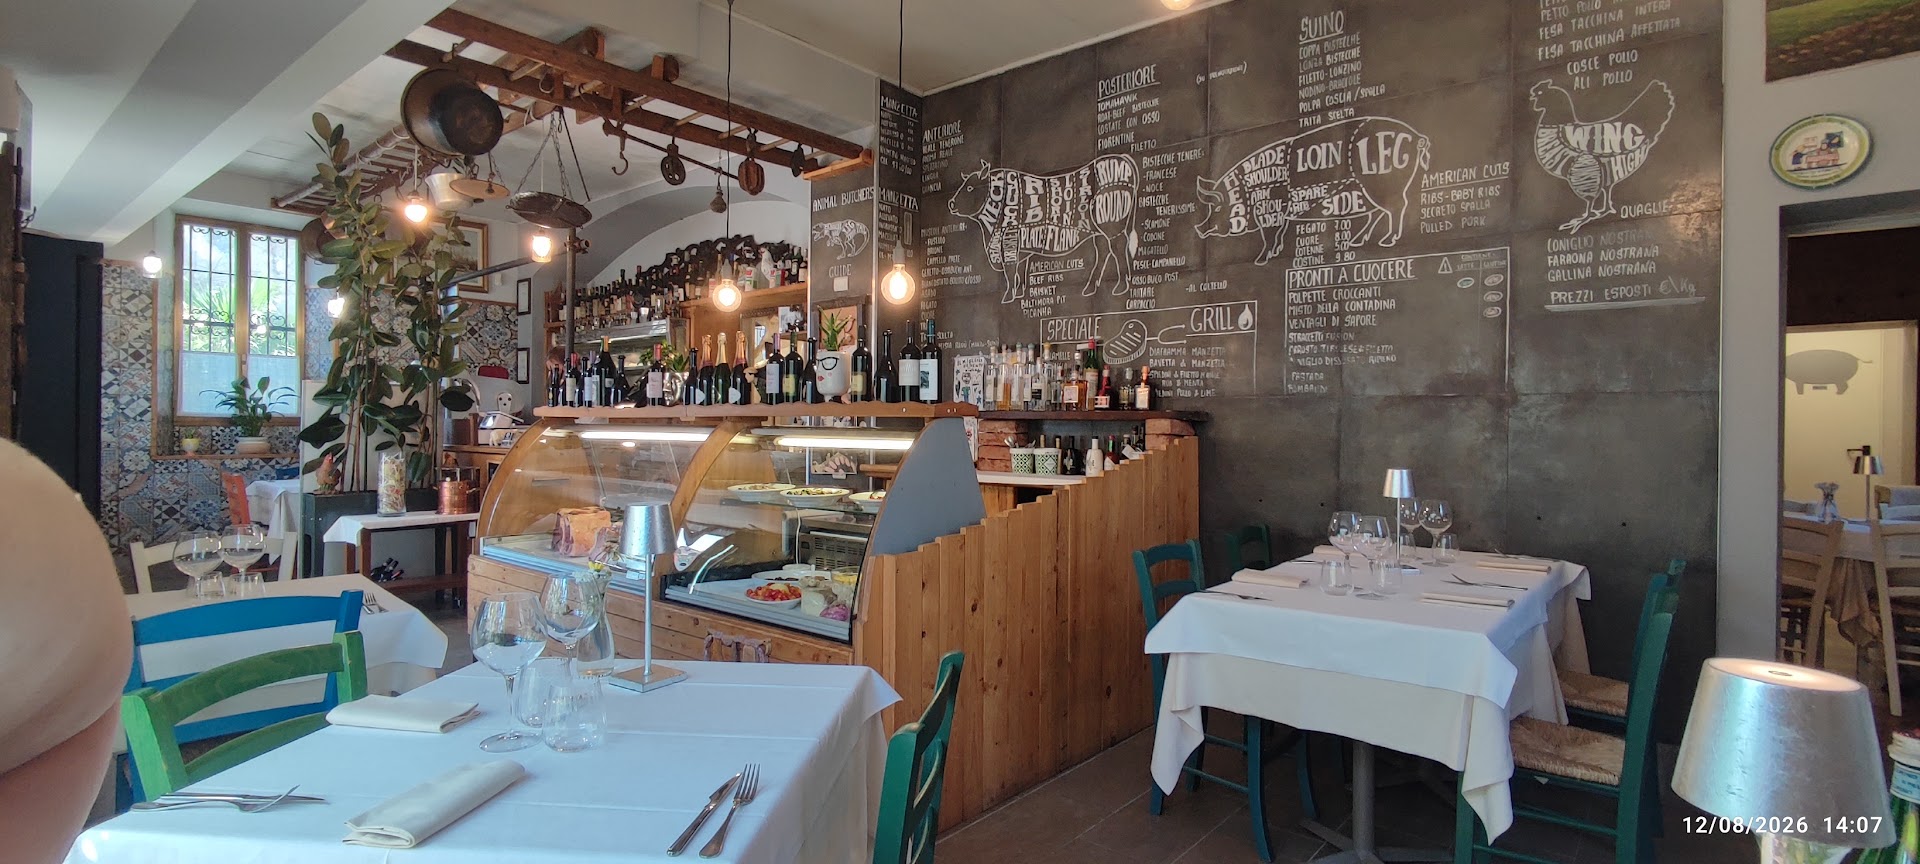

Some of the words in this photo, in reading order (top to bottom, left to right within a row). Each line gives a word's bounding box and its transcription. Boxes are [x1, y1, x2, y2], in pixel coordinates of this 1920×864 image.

[1540, 5, 1569, 22] PETTO
[1299, 10, 1344, 41] SUINO
[1540, 23, 1563, 40] FESA
[1571, 9, 1624, 31] TACCHINA
[1299, 44, 1320, 60] COPPA
[1324, 32, 1360, 53] BISTECCHE
[1538, 44, 1563, 61] FESA
[1570, 28, 1624, 53] TACCHINA
[1631, 17, 1681, 38] AFFETTATA
[1326, 46, 1361, 66] BISTECCHE
[1567, 56, 1600, 75] COSCE
[1609, 50, 1638, 66] POLLO
[1098, 63, 1157, 97] POSTERIORE
[1574, 76, 1590, 91] ALI
[1603, 70, 1633, 86] POLLO
[881, 95, 918, 118] MANZETTA
[1098, 93, 1138, 112] TOMAHAWK
[1299, 98, 1321, 113] POLPA
[1097, 122, 1122, 135] COSTATE
[1142, 110, 1161, 125] OSSO
[1298, 115, 1321, 128] TRITA
[1328, 108, 1355, 121] SCELTA
[922, 120, 962, 143] ANTERIORE
[1098, 132, 1135, 150] FIORENTINE
[1565, 121, 1646, 154] WING
[1130, 139, 1157, 153] FILETTO
[1356, 131, 1413, 175] LEG
[1142, 154, 1175, 169] BISTECCHE
[1242, 145, 1286, 175] BLADE
[1296, 141, 1343, 173] LOIN
[1600, 138, 1651, 187] THIGH
[1096, 158, 1132, 187] RUMP
[1243, 166, 1288, 187] SHOULDER
[1421, 167, 1478, 189] AMERICAN
[1483, 161, 1510, 178] CUTS
[812, 195, 838, 213] ANIMAL
[841, 186, 875, 206] BUTCHERS
[879, 186, 919, 210] MANZETTA
[1023, 176, 1045, 224] RIB
[1063, 175, 1073, 226] LOIN
[1223, 170, 1247, 234] HEAD
[1251, 188, 1271, 203] ARM
[1291, 186, 1329, 202] SPARE
[1478, 185, 1501, 198] RIBS
[978, 171, 1004, 234] NECK
[1095, 190, 1132, 225] ROUND
[1321, 191, 1367, 216] SIDE
[1420, 204, 1456, 219] SECRETO
[1460, 199, 1491, 213] SPALLA
[1620, 201, 1669, 219] QUAGLIE
[1259, 213, 1285, 228] LDER
[1296, 222, 1327, 235] FEGATO
[1420, 220, 1453, 234] PULLED
[1461, 216, 1487, 229] PORK
[1020, 227, 1044, 249] PLATE
[1045, 225, 1080, 252] FLANK
[1295, 235, 1320, 248] CUORE
[1547, 234, 1594, 253] CONIGLIO
[1295, 244, 1324, 257] COTENNE
[1547, 251, 1593, 268] FARAONA
[1600, 245, 1659, 262] NOSTRANA
[828, 264, 852, 279] GUIDE
[1029, 260, 1064, 273] AMERICAN
[1066, 259, 1084, 269] CUTS
[1292, 255, 1326, 269] COSTINE
[1547, 266, 1592, 282] GALLINA
[1598, 261, 1657, 278] NOSTRANA
[1029, 276, 1045, 286] BEEF
[1047, 274, 1064, 283] RIBS
[1289, 268, 1334, 289] PRONTI
[1337, 267, 1349, 284] A
[1354, 259, 1416, 282] CUOCERE
[1029, 285, 1057, 297] BRISKET
[1130, 287, 1155, 298] TARTARE
[1288, 290, 1327, 304] POLPETTE
[1333, 286, 1381, 301] CROCCANTI
[1550, 290, 1594, 305] PREZZI
[1604, 284, 1651, 300] ESPOSTI
[1021, 296, 1054, 310] BALTIMORA
[1023, 307, 1052, 319] PICANHA
[1126, 299, 1156, 310] CARPACCIO
[1288, 304, 1313, 316] MISTO
[1317, 302, 1339, 314] DELLA
[1345, 299, 1396, 312] CONTADINA
[1047, 317, 1102, 341] SPECIALE
[1190, 307, 1234, 332] GRILL
[1288, 317, 1327, 330] VENTAGLI
[1344, 314, 1377, 327] SAPORE
[1149, 358, 1176, 368] BAVETTA
